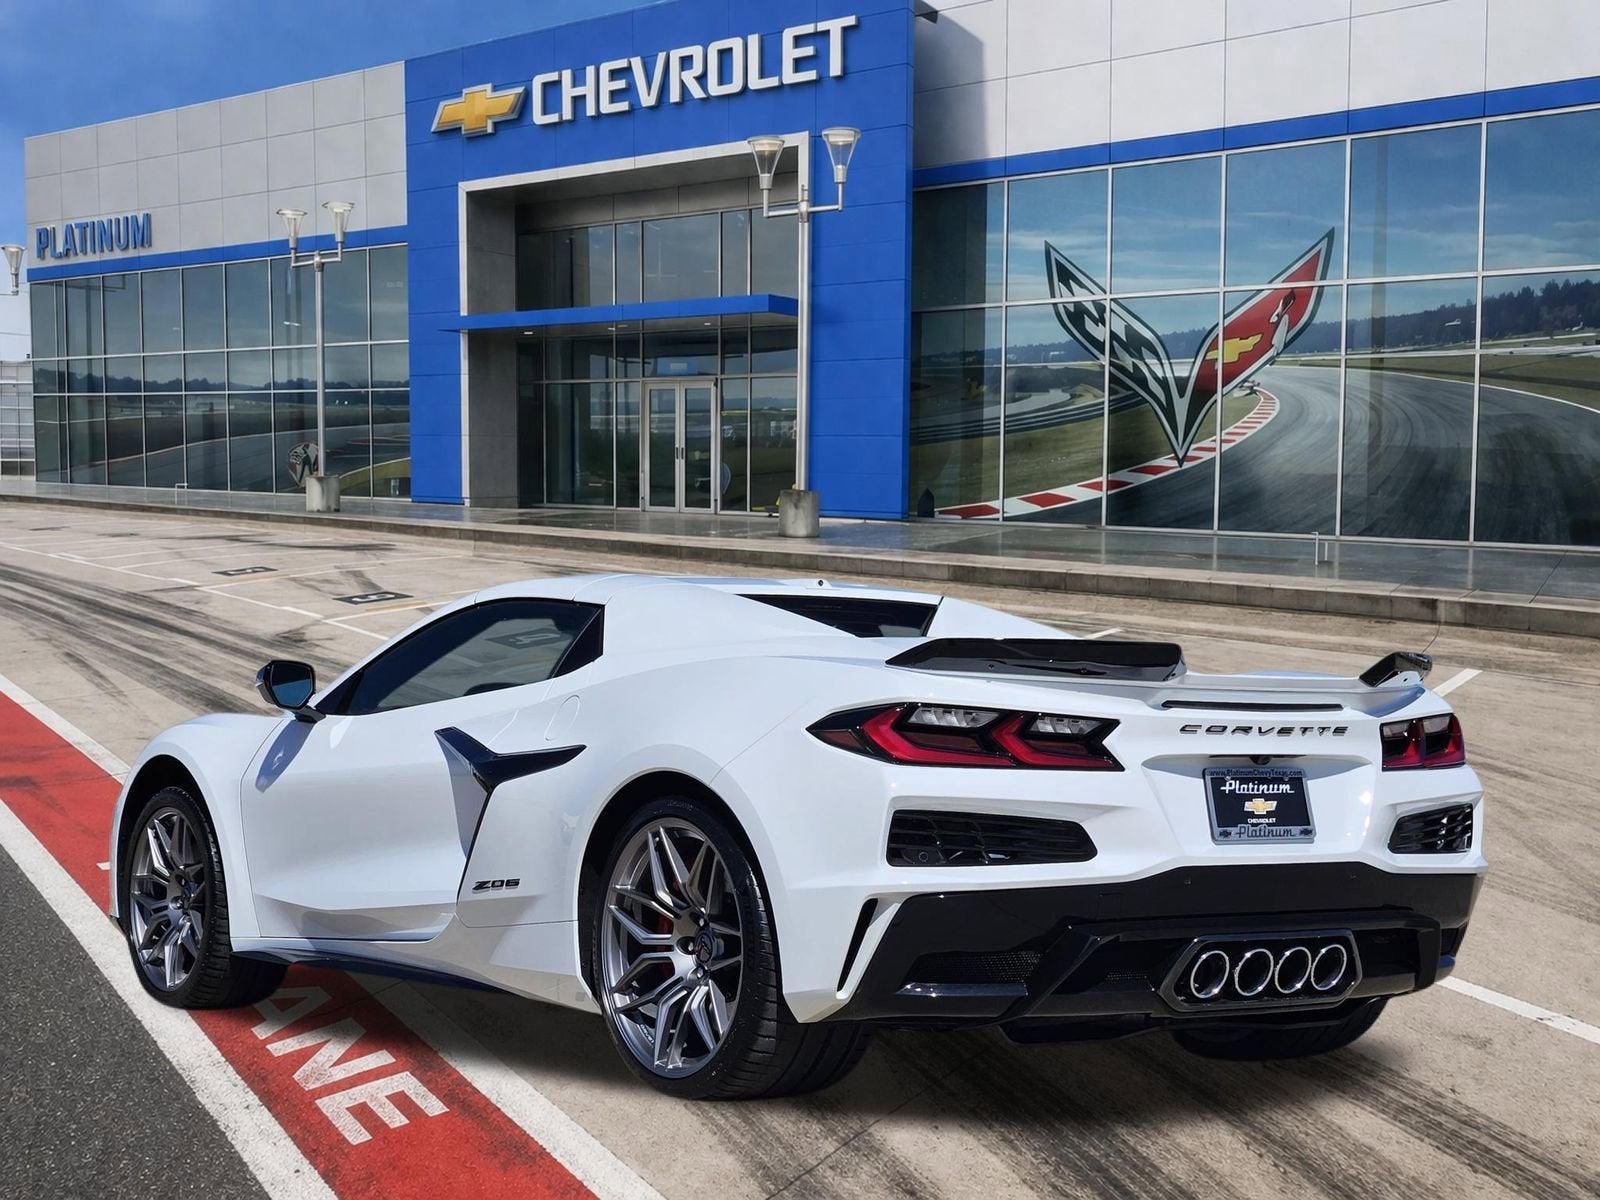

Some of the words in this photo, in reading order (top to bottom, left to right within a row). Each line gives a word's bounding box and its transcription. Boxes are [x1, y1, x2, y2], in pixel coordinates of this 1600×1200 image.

[532, 15, 859, 125] CHEVROLET
[36, 213, 152, 260] PLATINUM
[1179, 724, 1348, 737] CORVETTE
[1220, 780, 1295, 794] Platinum
[1235, 825, 1297, 838] Platinum
[472, 878, 521, 891] Z06
[251, 986, 450, 1146] ANE
